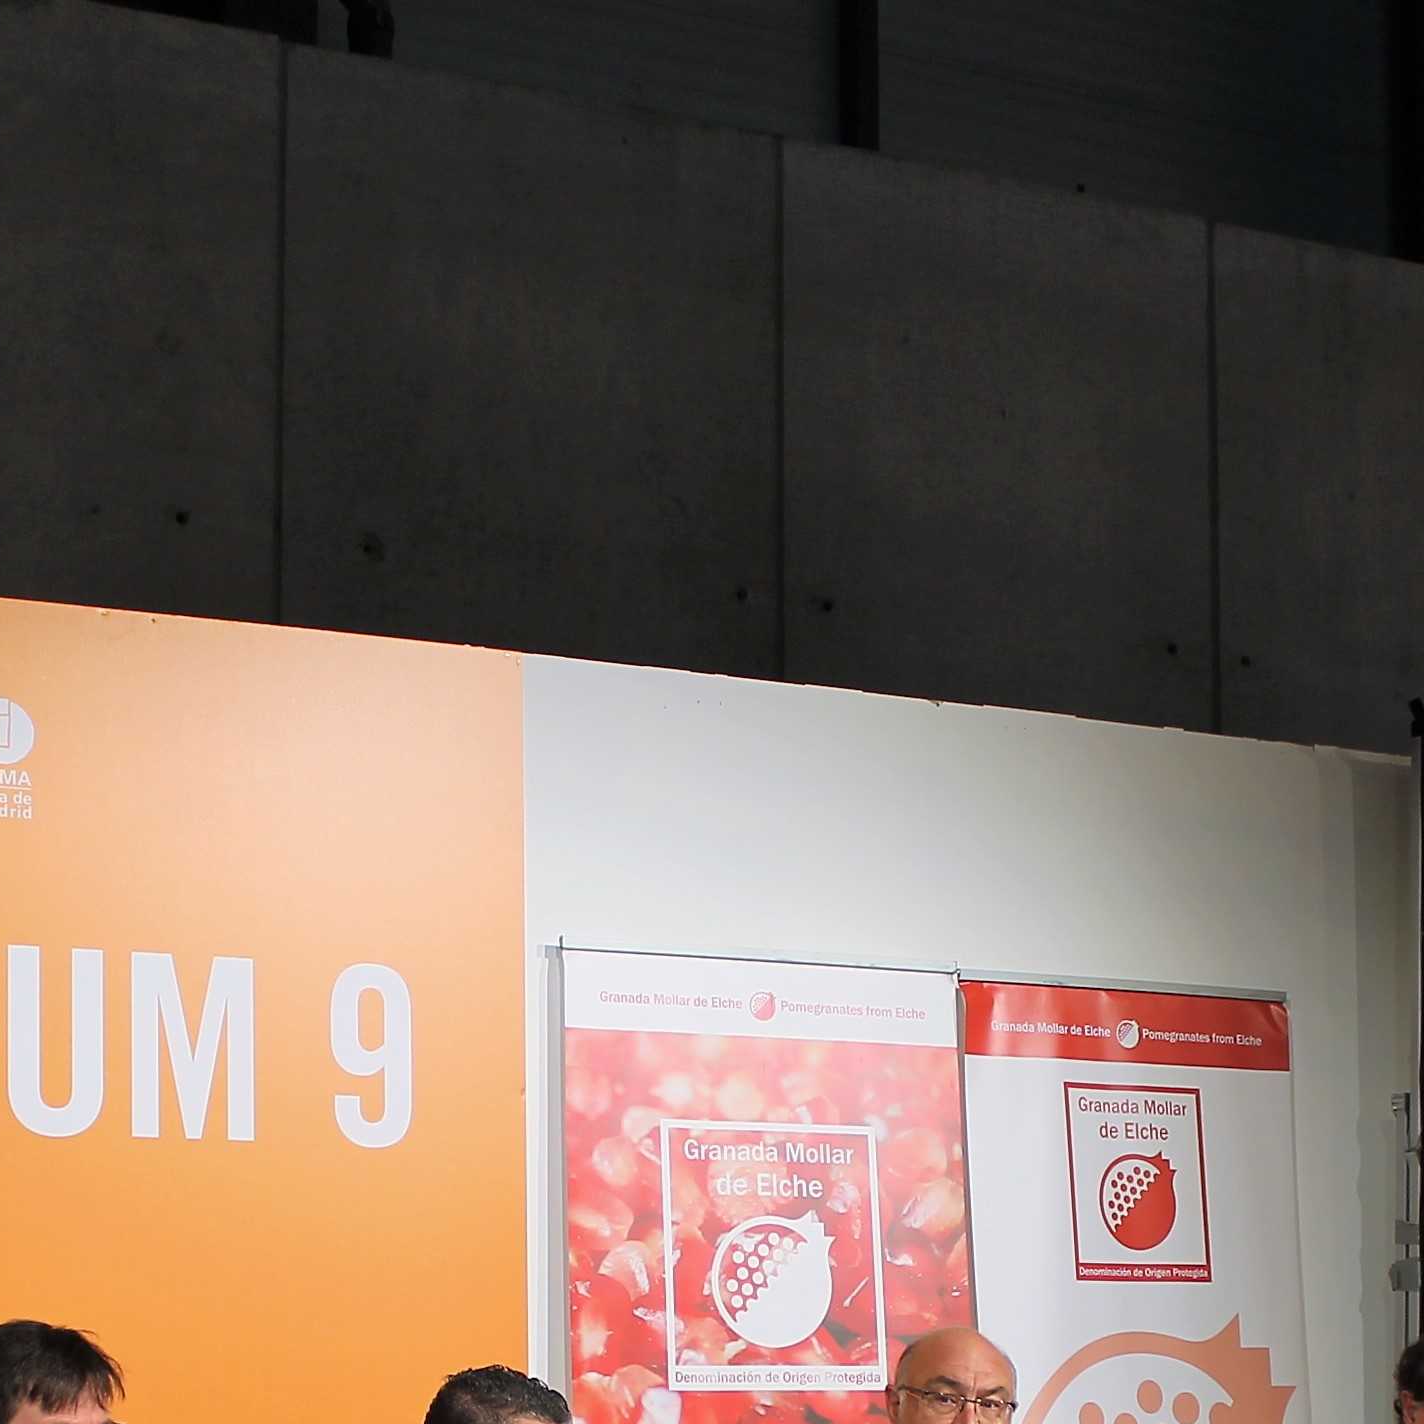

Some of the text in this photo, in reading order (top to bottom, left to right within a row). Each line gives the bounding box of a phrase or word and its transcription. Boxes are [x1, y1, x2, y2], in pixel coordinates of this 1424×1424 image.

[13, 791, 33, 806] de
[599, 991, 743, 1009] Granada Mollar de Elche
[780, 1000, 926, 1020] Pomegranates from Elche
[991, 1020, 1111, 1037] Granada Mollar de Elche
[1142, 1028, 1262, 1047] Pomegranates from Elche
[330, 962, 413, 1149] 9
[1078, 1096, 1187, 1116] Granada Mollar
[1099, 1122, 1169, 1140] de Elche
[683, 1138, 854, 1165] Granada Mollar
[716, 1173, 824, 1198] de Elche
[1079, 1266, 1131, 1277] Denominación
[1133, 1267, 1143, 1277] de
[1145, 1267, 1171, 1279] Origen
[675, 1370, 881, 1386] Denominación de Origen Protegida
